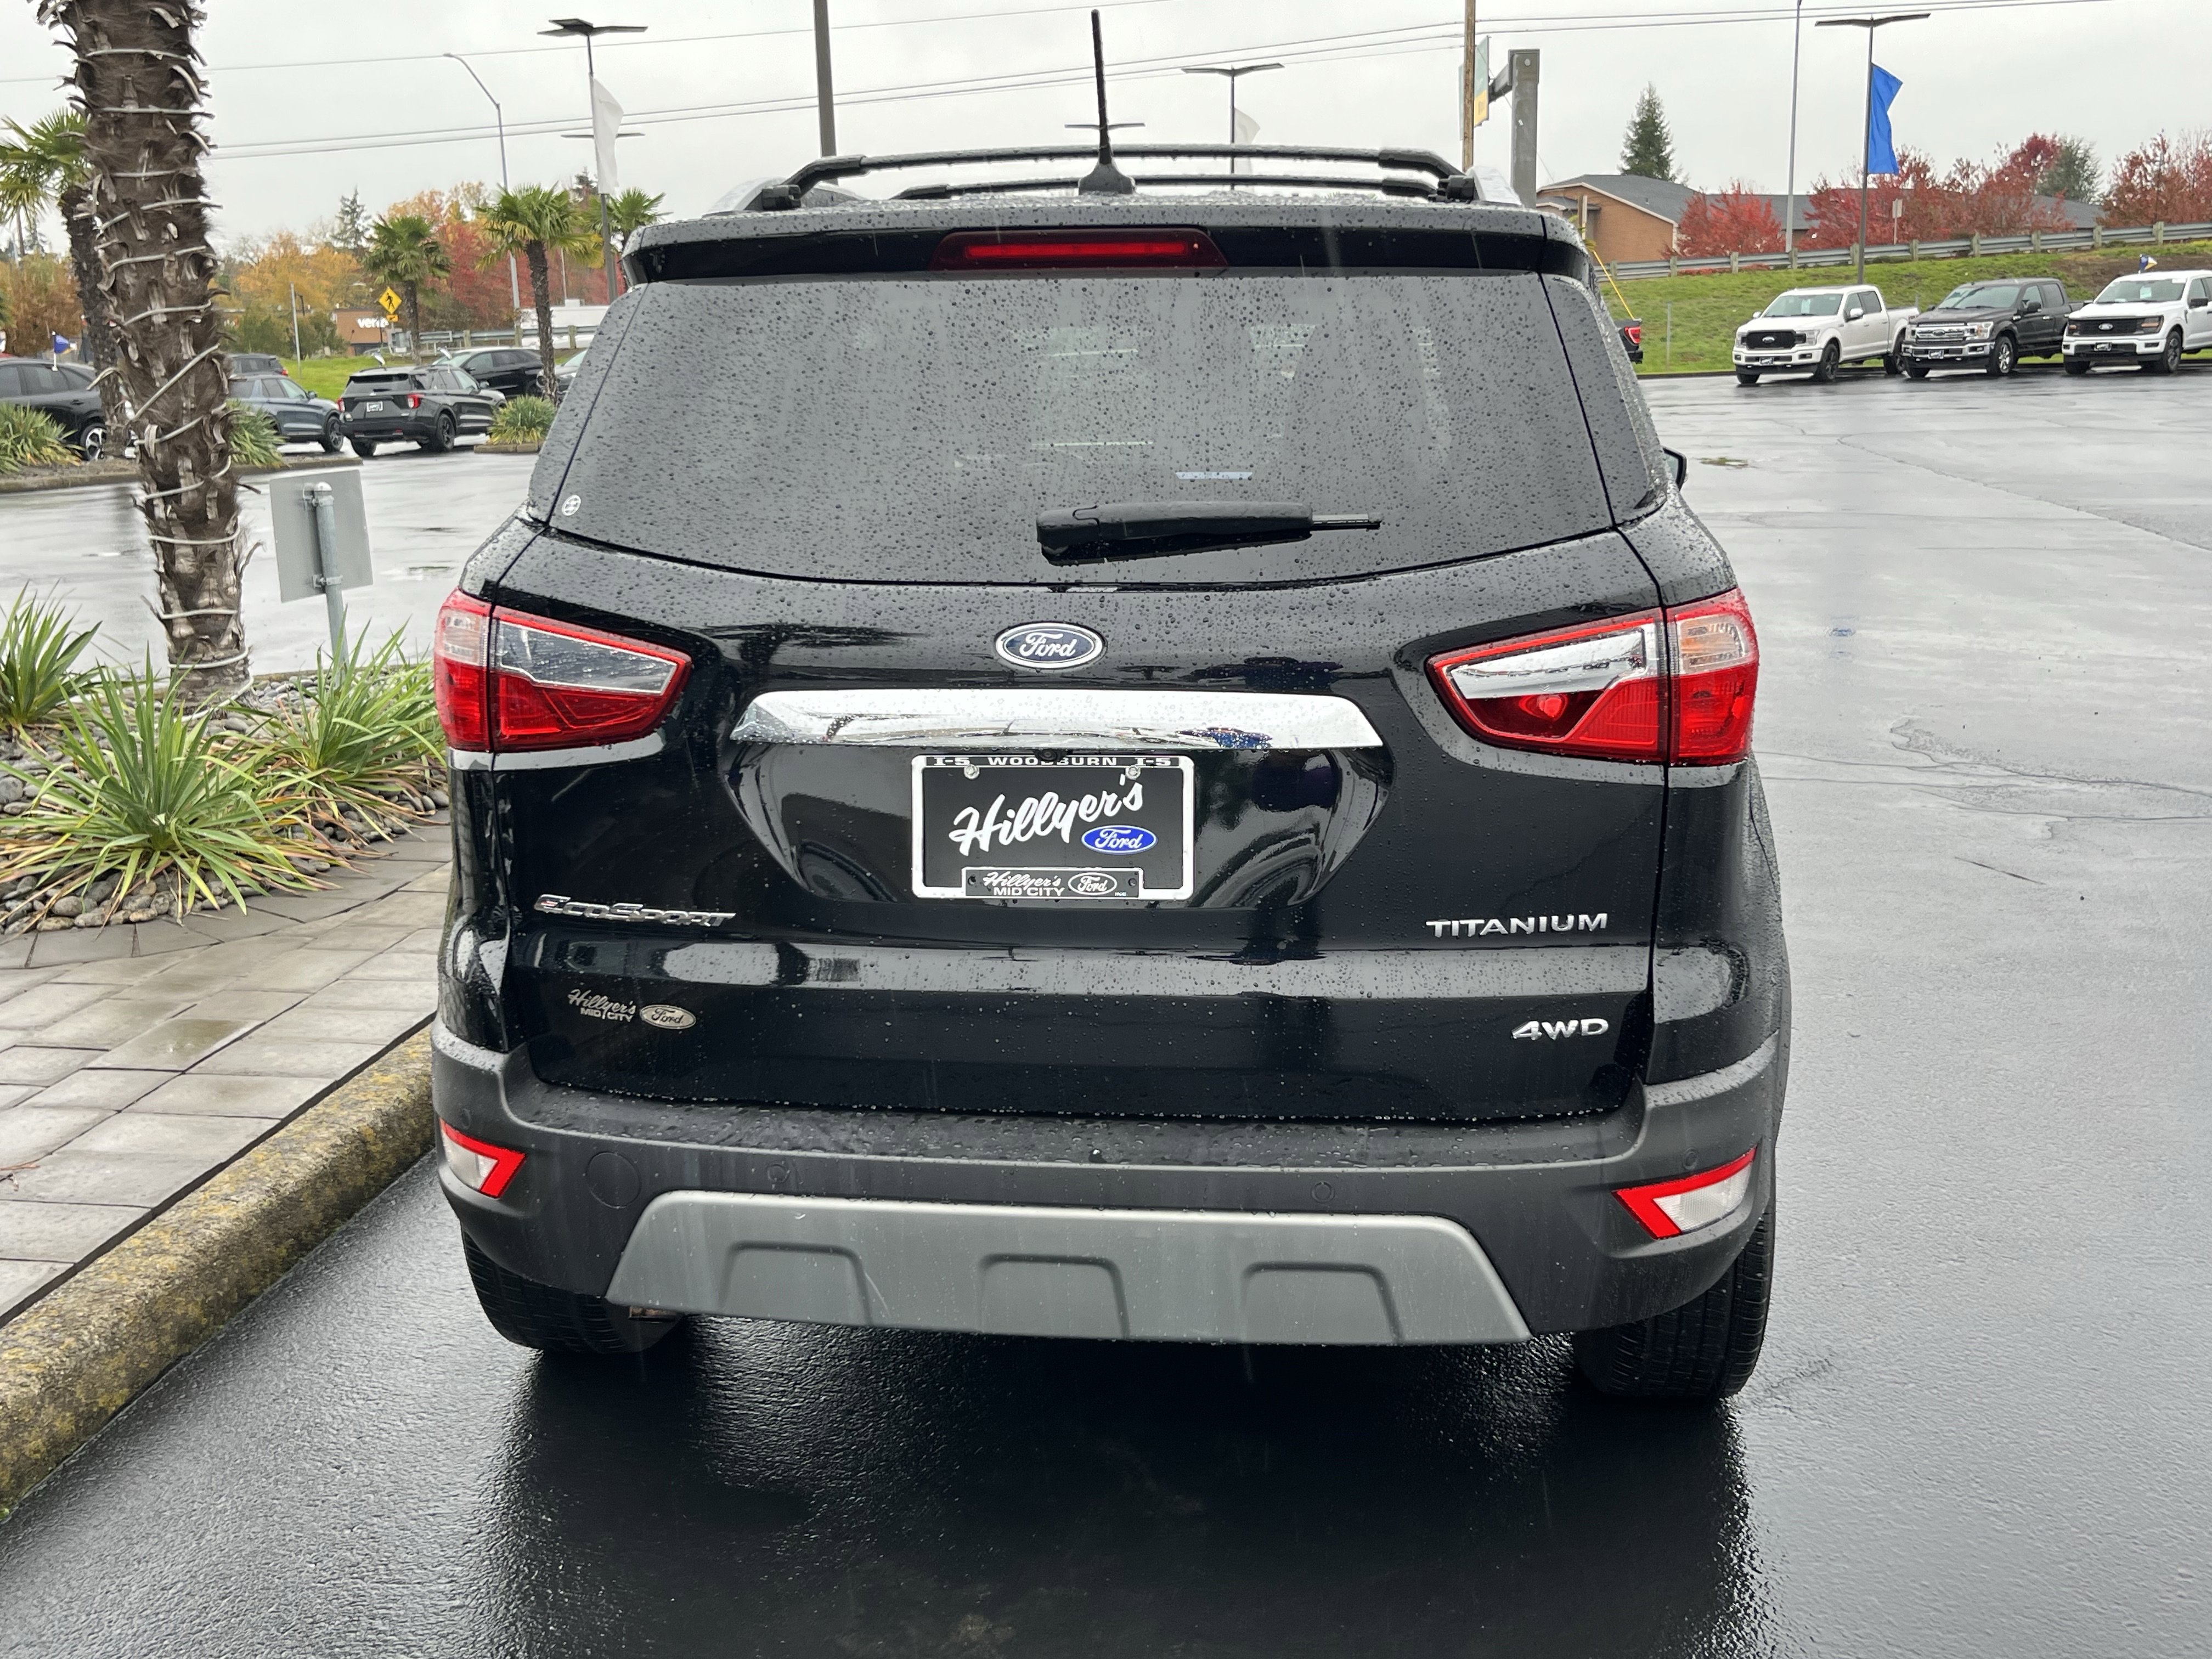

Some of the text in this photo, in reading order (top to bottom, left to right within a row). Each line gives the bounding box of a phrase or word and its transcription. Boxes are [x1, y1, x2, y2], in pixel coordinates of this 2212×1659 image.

[1019, 632, 1077, 657] Ford
[934, 757, 970, 766] I-5
[1135, 757, 1171, 766] I-5
[949, 774, 1143, 856] Hillyer's
[1094, 826, 1142, 849] Ford
[983, 871, 1062, 890] Hillyer's
[1077, 876, 1107, 892] Ford
[994, 887, 1065, 896] MID CITY
[1426, 913, 1608, 937] TITANIUM
[567, 989, 637, 1020] Hillyer's
[580, 1007, 635, 1022] MID CITY
[650, 1007, 684, 1024] Ford
[1511, 1018, 1609, 1041] 4WD
